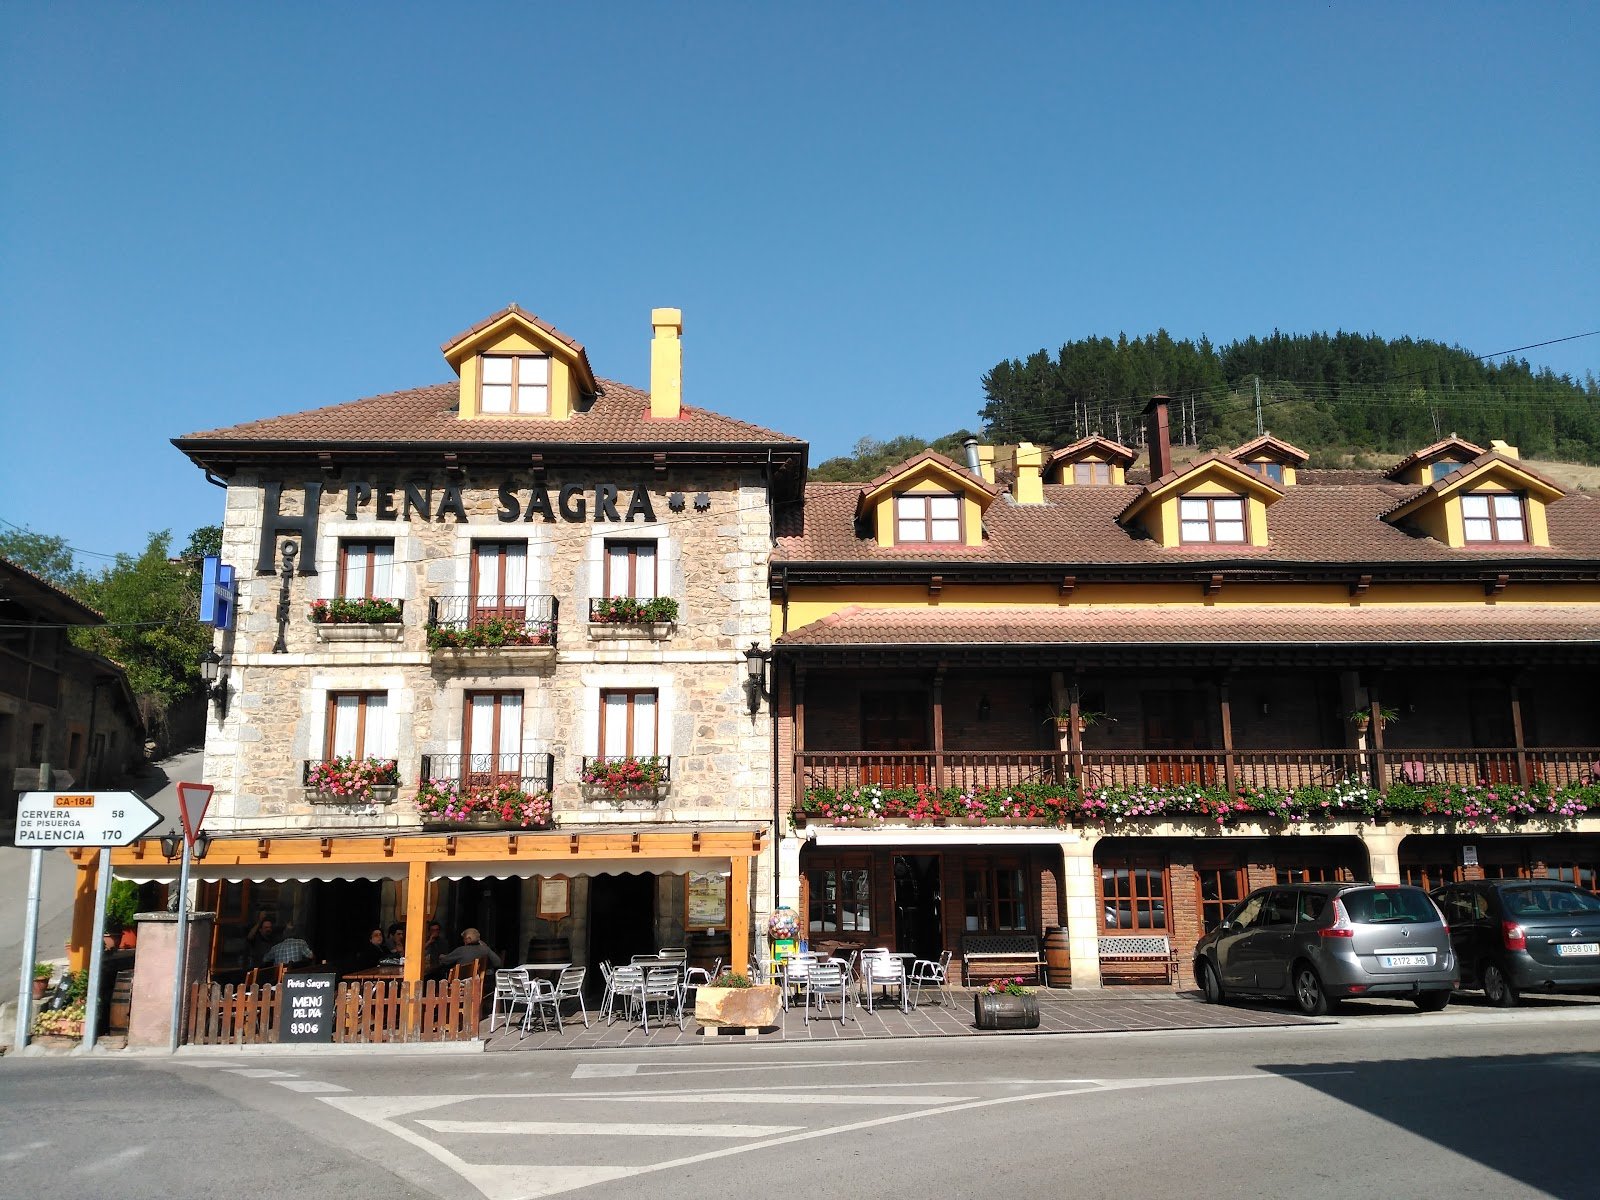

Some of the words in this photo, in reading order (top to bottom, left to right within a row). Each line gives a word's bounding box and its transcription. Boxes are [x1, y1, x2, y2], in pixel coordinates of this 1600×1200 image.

[497, 481, 658, 523] SAGRA
[55, 797, 92, 806] CA-184
[21, 810, 71, 819] CERVERA
[111, 810, 125, 819] 58
[19, 830, 85, 840] PALENCIA
[102, 830, 122, 840] 170
[1562, 945, 1582, 953] 0958
[1392, 956, 1411, 966] 2172
[306, 979, 330, 989] Sagra
[292, 996, 322, 1007] MENÚ
[293, 1008, 307, 1018] DEL
